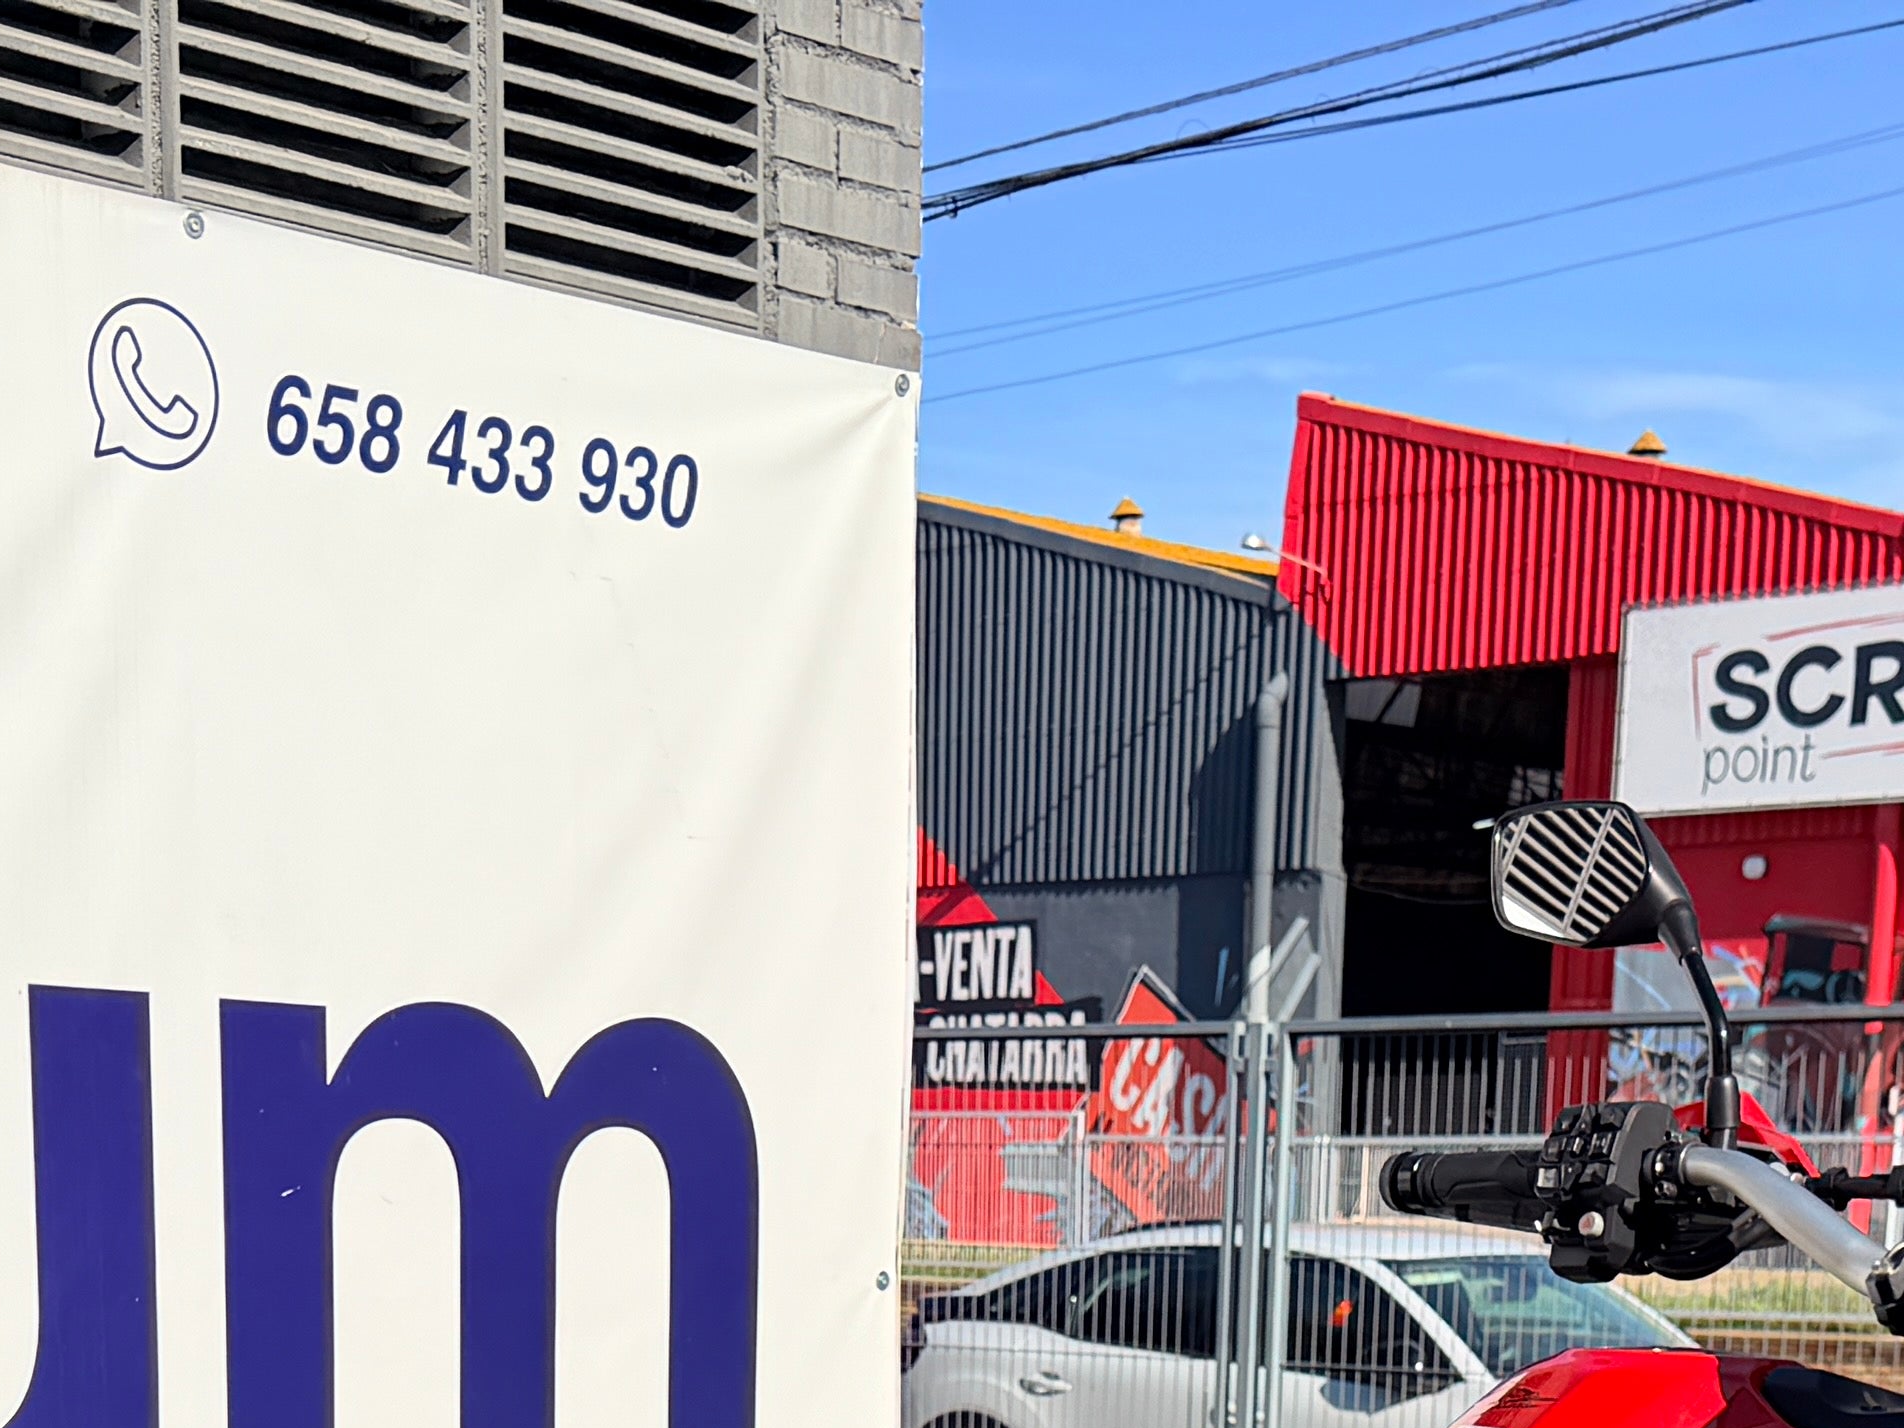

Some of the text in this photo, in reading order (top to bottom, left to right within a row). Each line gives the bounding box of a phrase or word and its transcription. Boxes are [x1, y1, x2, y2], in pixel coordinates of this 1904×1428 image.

[267, 375, 698, 528] 658 433 930
[1702, 731, 1817, 796] point
